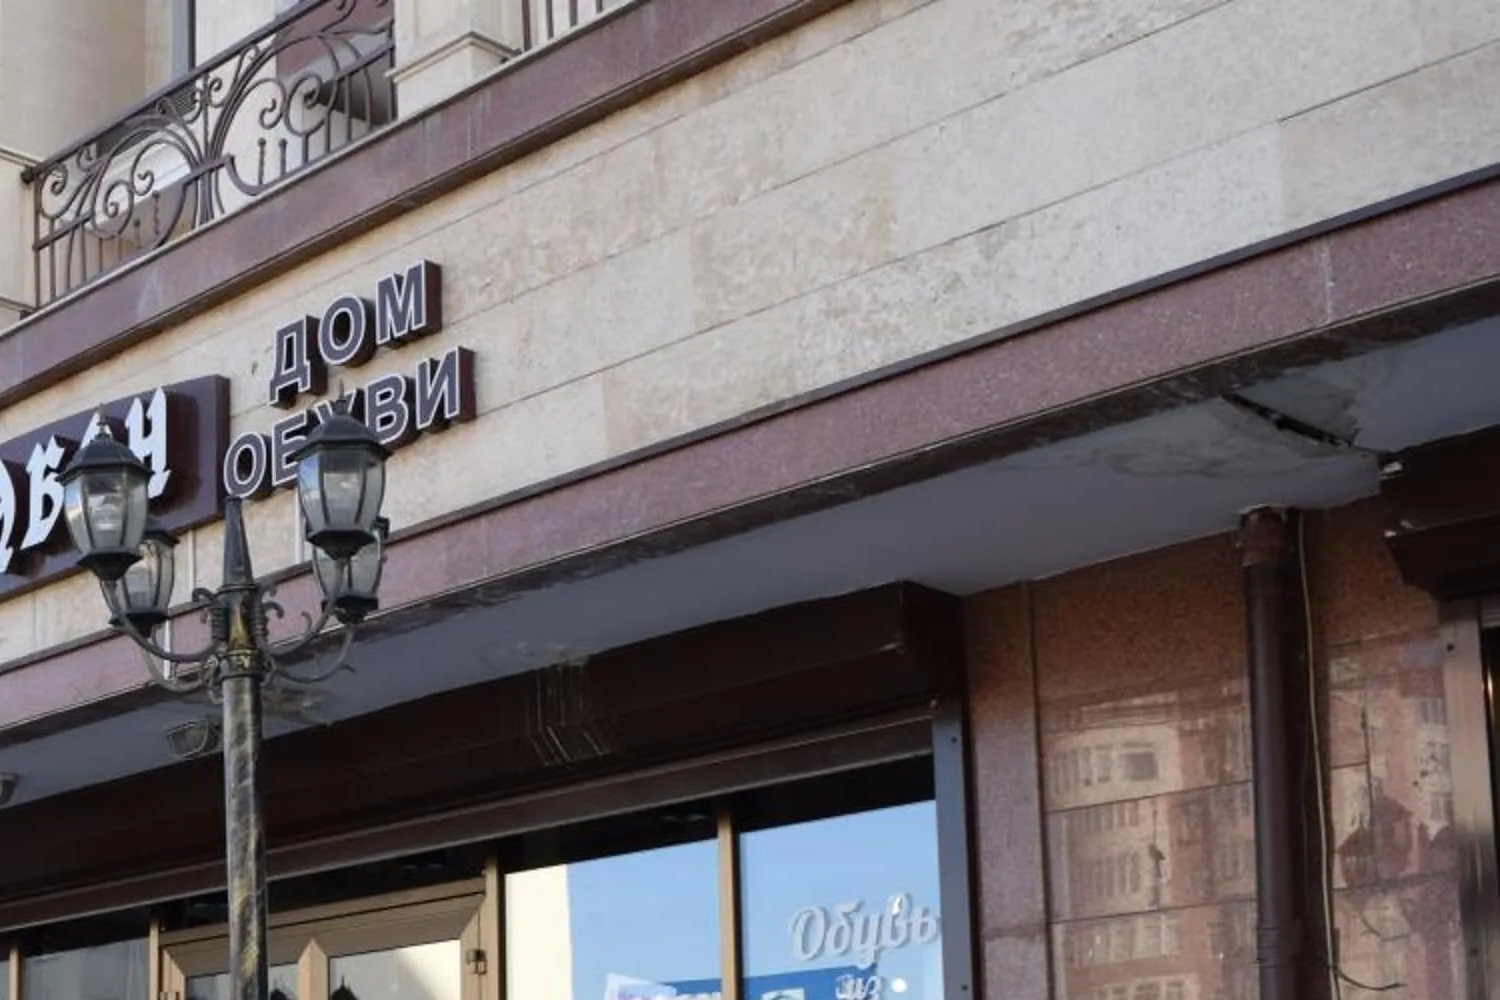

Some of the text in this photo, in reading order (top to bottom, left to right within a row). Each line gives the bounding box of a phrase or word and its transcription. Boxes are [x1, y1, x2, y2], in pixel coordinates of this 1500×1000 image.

[269, 259, 427, 405] ДОМ
[224, 346, 461, 498] ОБВИ
[791, 893, 938, 969] Обувь
